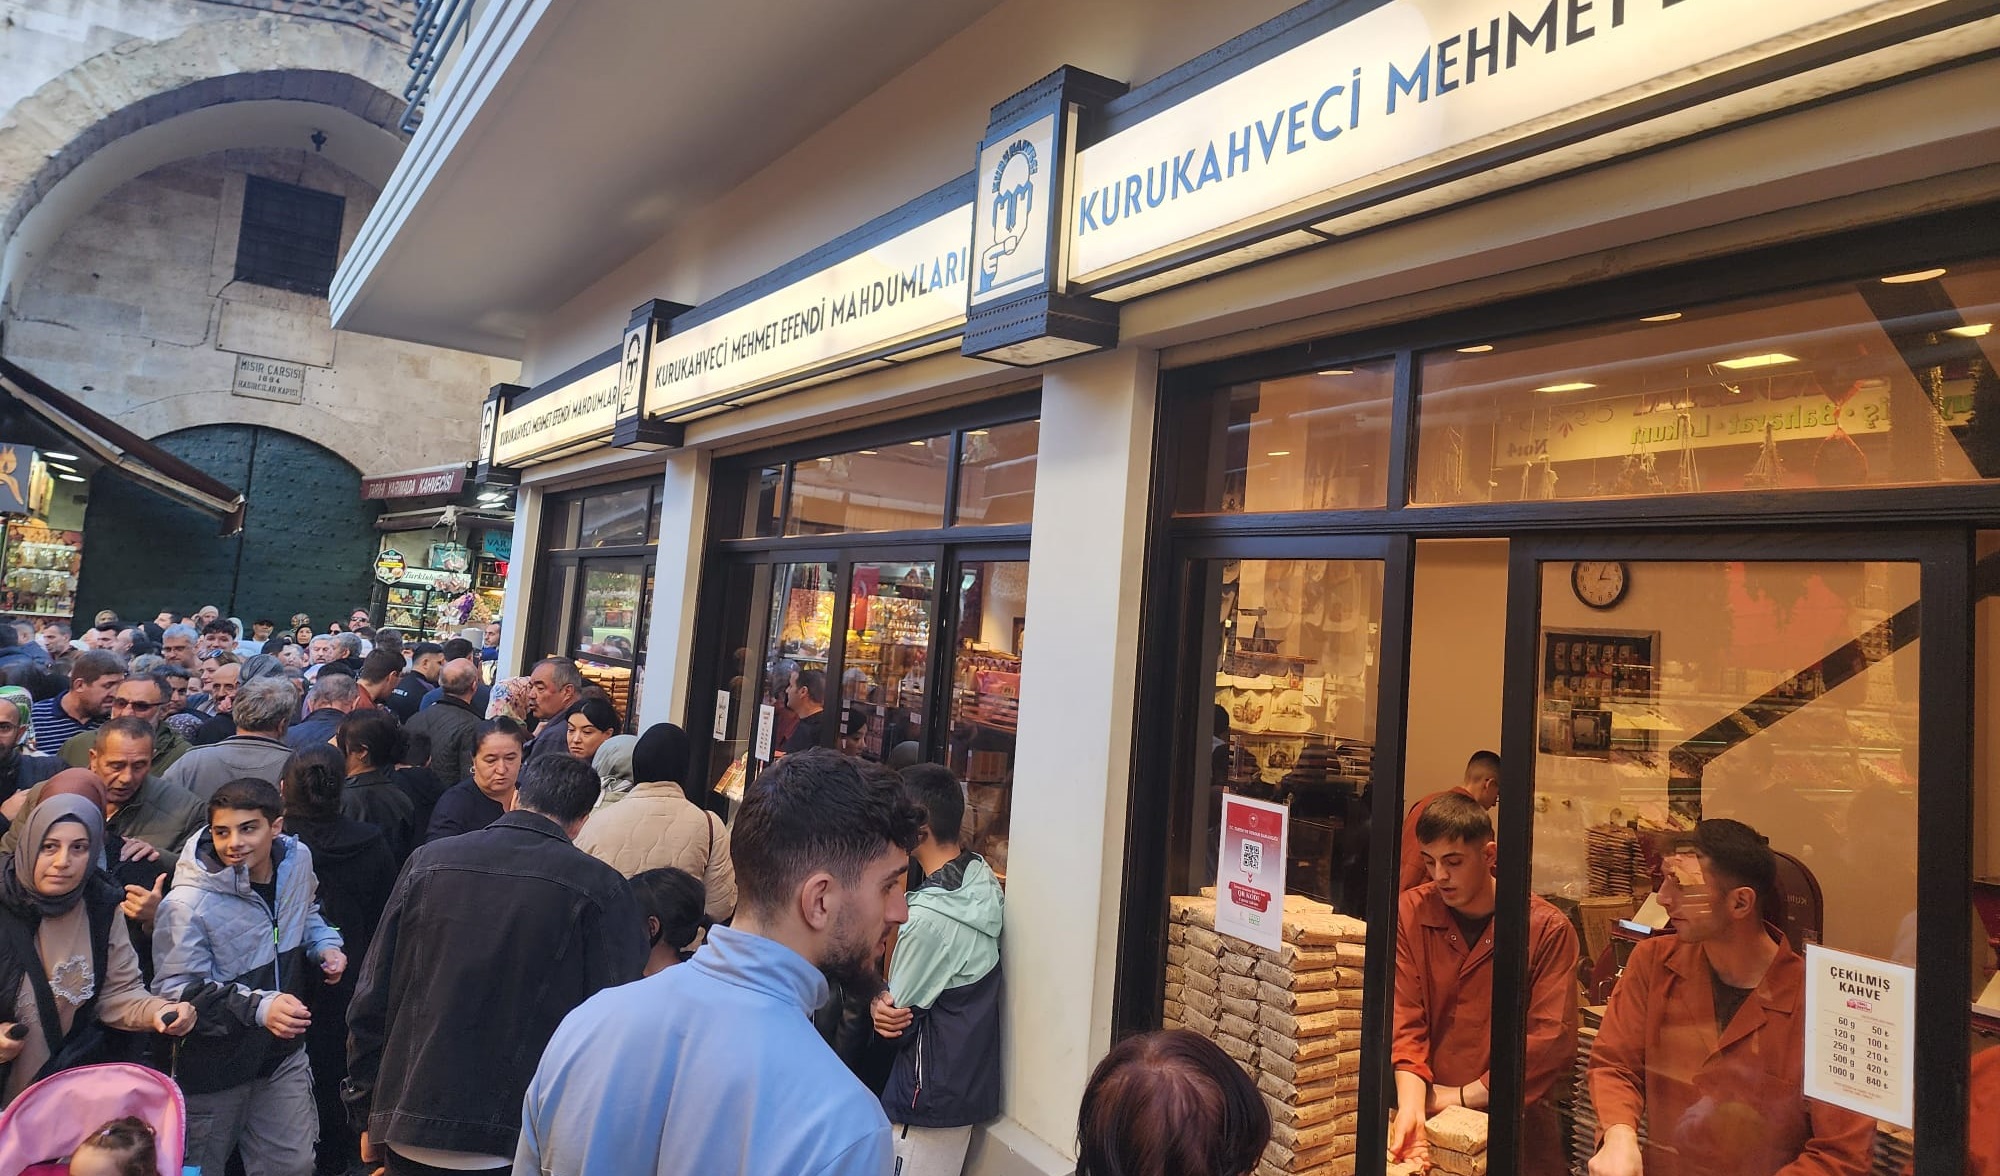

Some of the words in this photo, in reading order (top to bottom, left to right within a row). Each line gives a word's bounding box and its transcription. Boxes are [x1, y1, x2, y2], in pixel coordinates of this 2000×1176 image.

[1079, 67, 1361, 235] KURUKAHVECİ
[655, 337, 728, 388] KURUKAHVECİ
[731, 322, 779, 363] MEHMET
[780, 297, 825, 344] EFENDİ
[831, 246, 966, 327] MAHDUMLARI
[500, 415, 533, 446] KURUKAHVECİ
[531, 411, 553, 434] MEHMET
[551, 400, 572, 427] EFENDİ
[1830, 966, 1891, 992] ÇEKİLMİŞ
[1839, 981, 1881, 1001] KAHVE
[1838, 1016, 1848, 1026] 60
[1872, 1025, 1882, 1036] 50
[1833, 1028, 1848, 1039] 120
[1867, 1037, 1882, 1049] 100
[1833, 1040, 1848, 1052] 250
[1866, 1050, 1882, 1062] 210
[1833, 1053, 1848, 1065] 500
[1866, 1063, 1882, 1075] 420
[1828, 1065, 1848, 1077] 1000
[1866, 1076, 1881, 1088] 840
